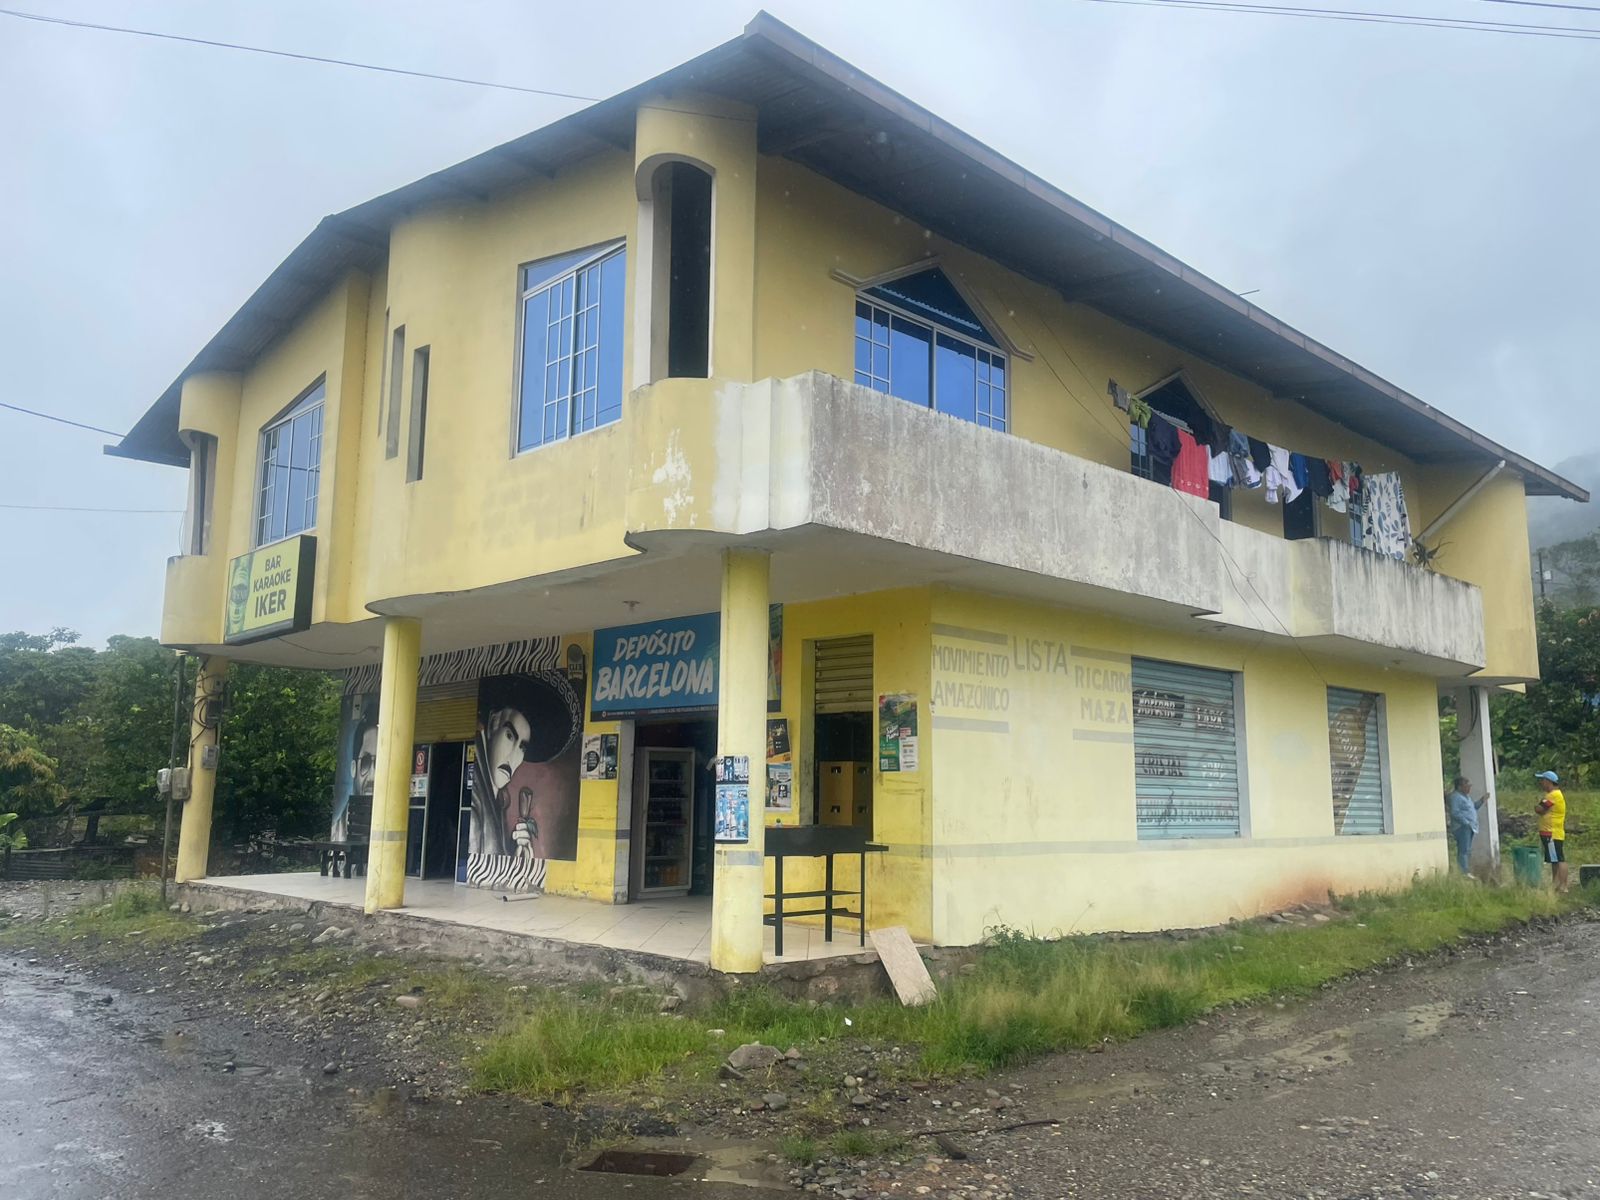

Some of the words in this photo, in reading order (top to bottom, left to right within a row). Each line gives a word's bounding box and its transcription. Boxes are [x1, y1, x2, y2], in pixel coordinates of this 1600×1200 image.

[265, 555, 281, 572] BAR
[253, 569, 291, 592] KARAOKE
[254, 589, 287, 618] IKER
[612, 629, 696, 662] DEPÓSITO
[1013, 636, 1068, 675] LISTA
[931, 645, 1010, 679] MOVIMIENTO
[595, 657, 713, 701] BARCELONA
[933, 680, 1010, 712] AMAZÓNICO
[1080, 696, 1129, 724] MAZA
